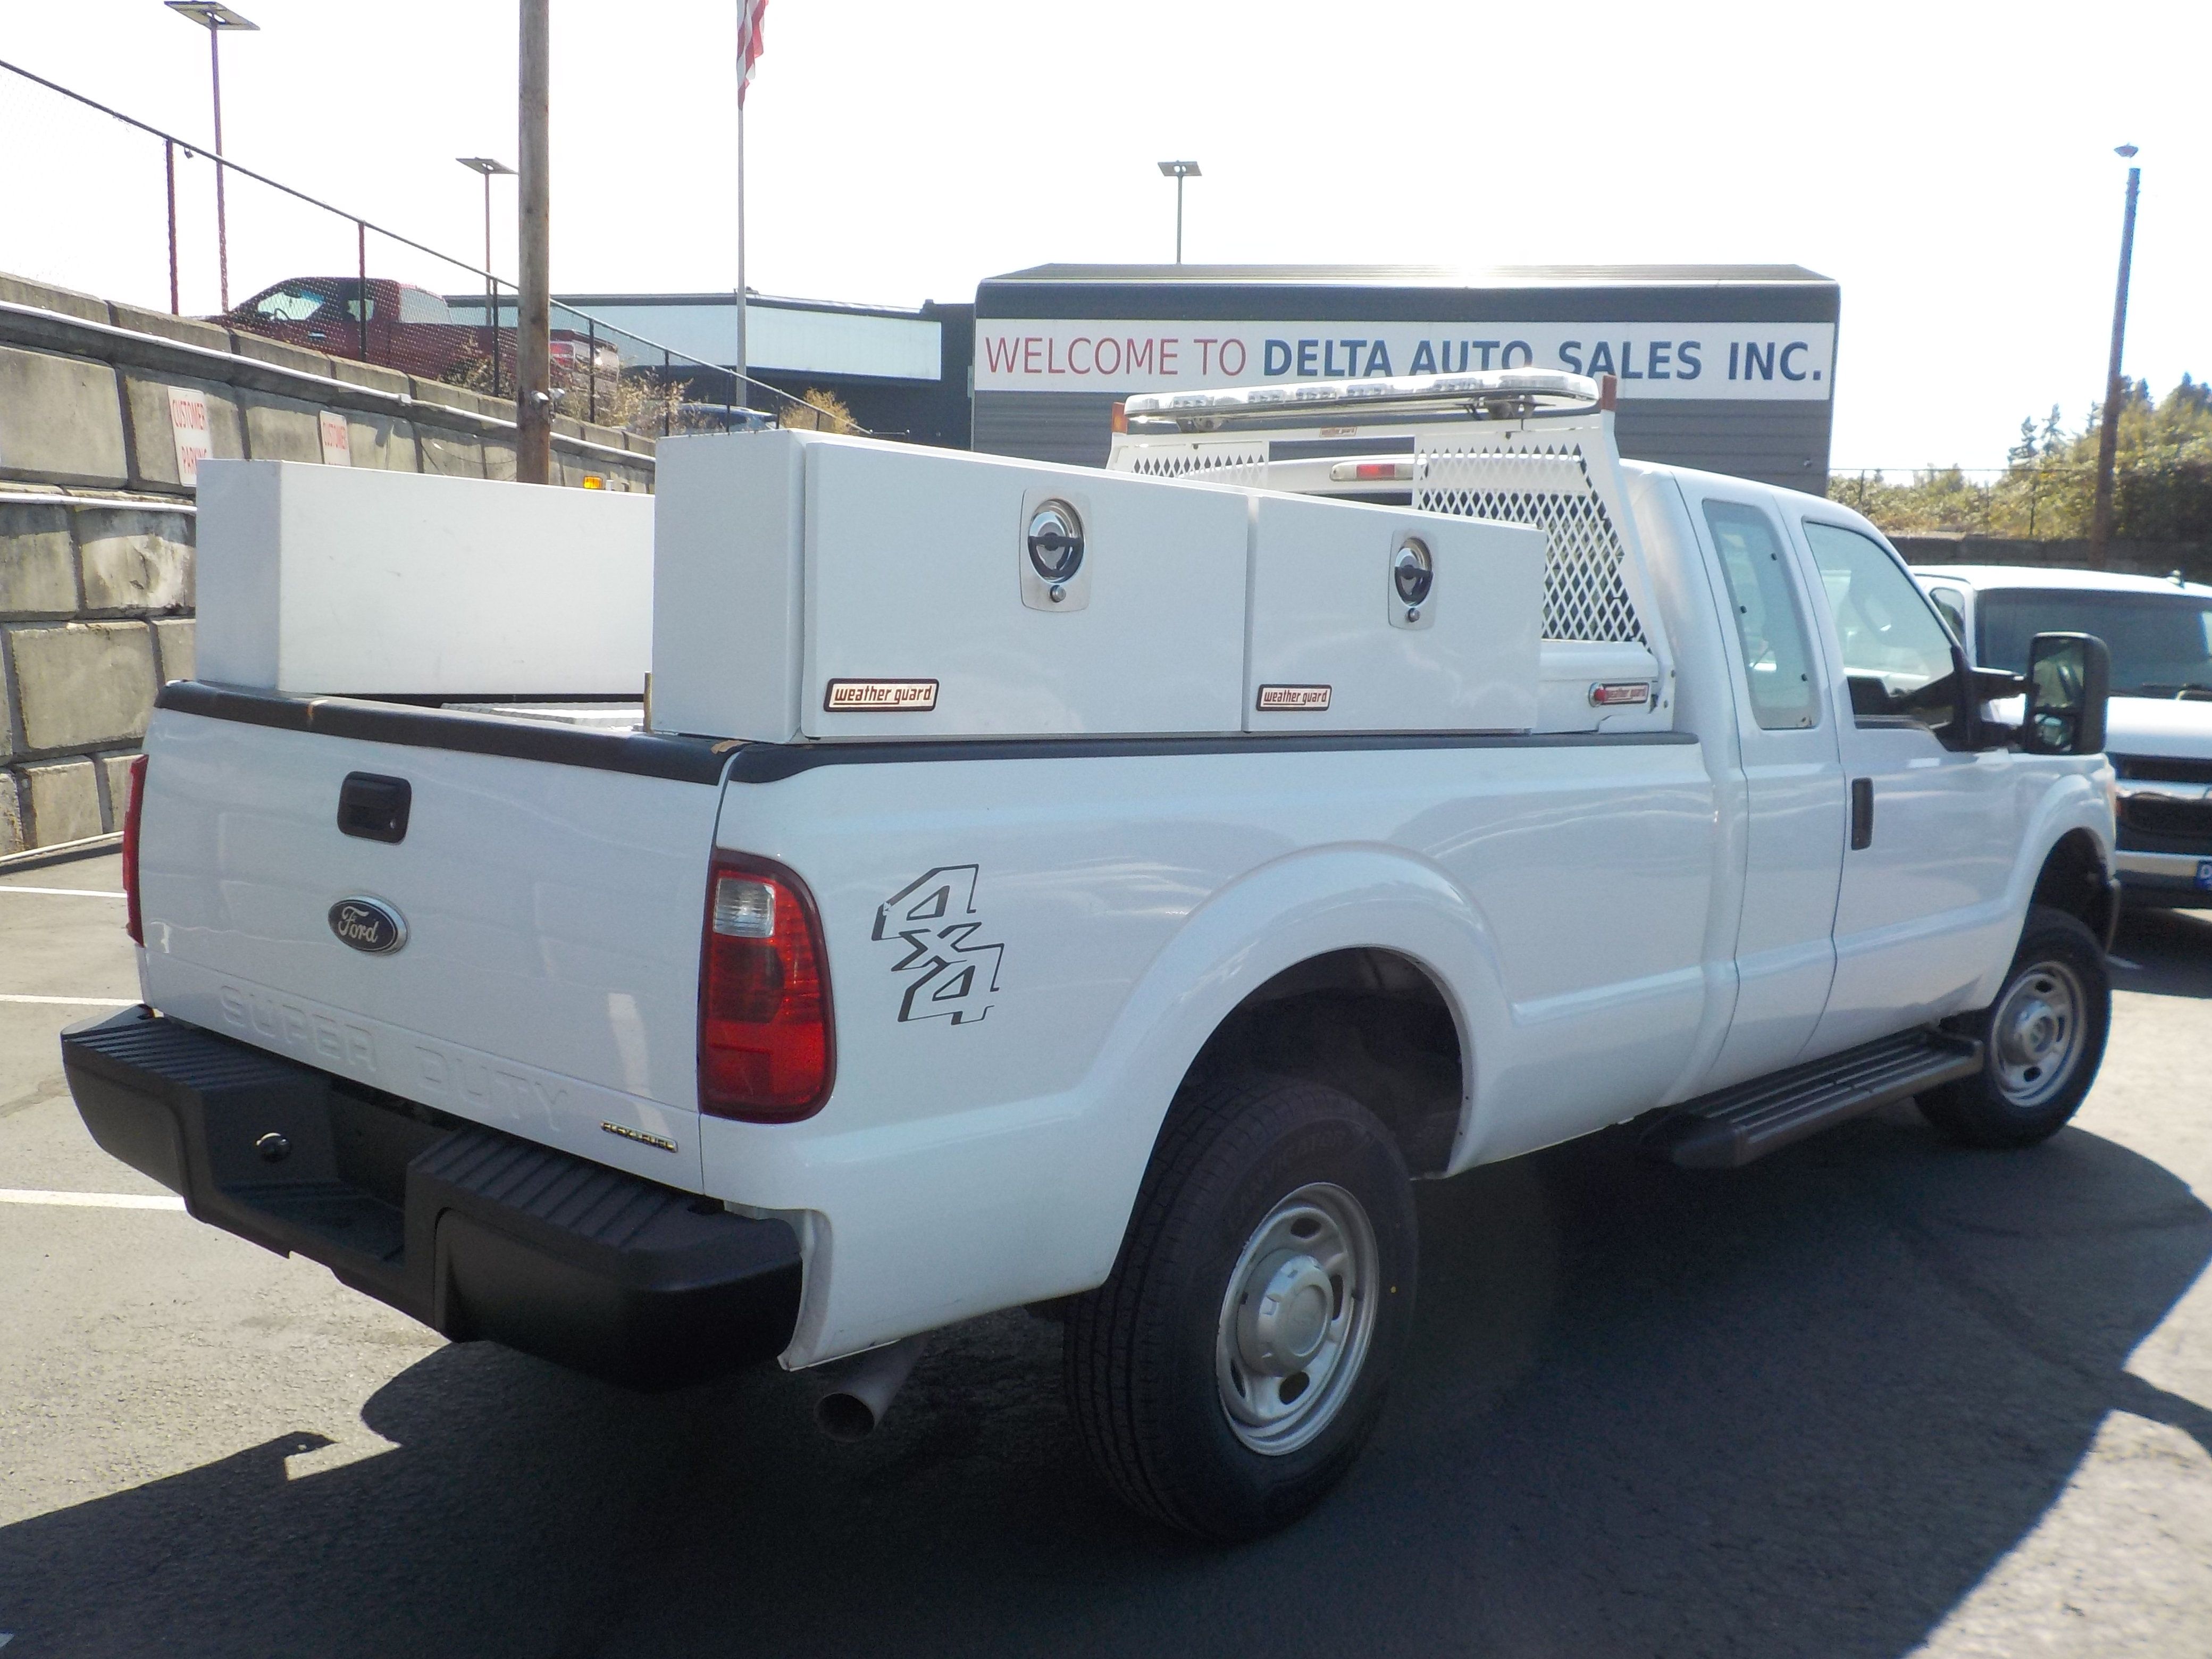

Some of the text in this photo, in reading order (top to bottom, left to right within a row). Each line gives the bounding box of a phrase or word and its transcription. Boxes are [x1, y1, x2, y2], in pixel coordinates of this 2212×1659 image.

[985, 337, 1822, 381] WELCOME TO DELTA AUTO SALES INC.
[172, 399, 206, 431] CUSTOMER
[833, 685, 933, 705] weather guard
[1263, 689, 1328, 706] weather guard
[338, 905, 380, 943] Ford
[220, 985, 569, 1133] SUPER DUTY
